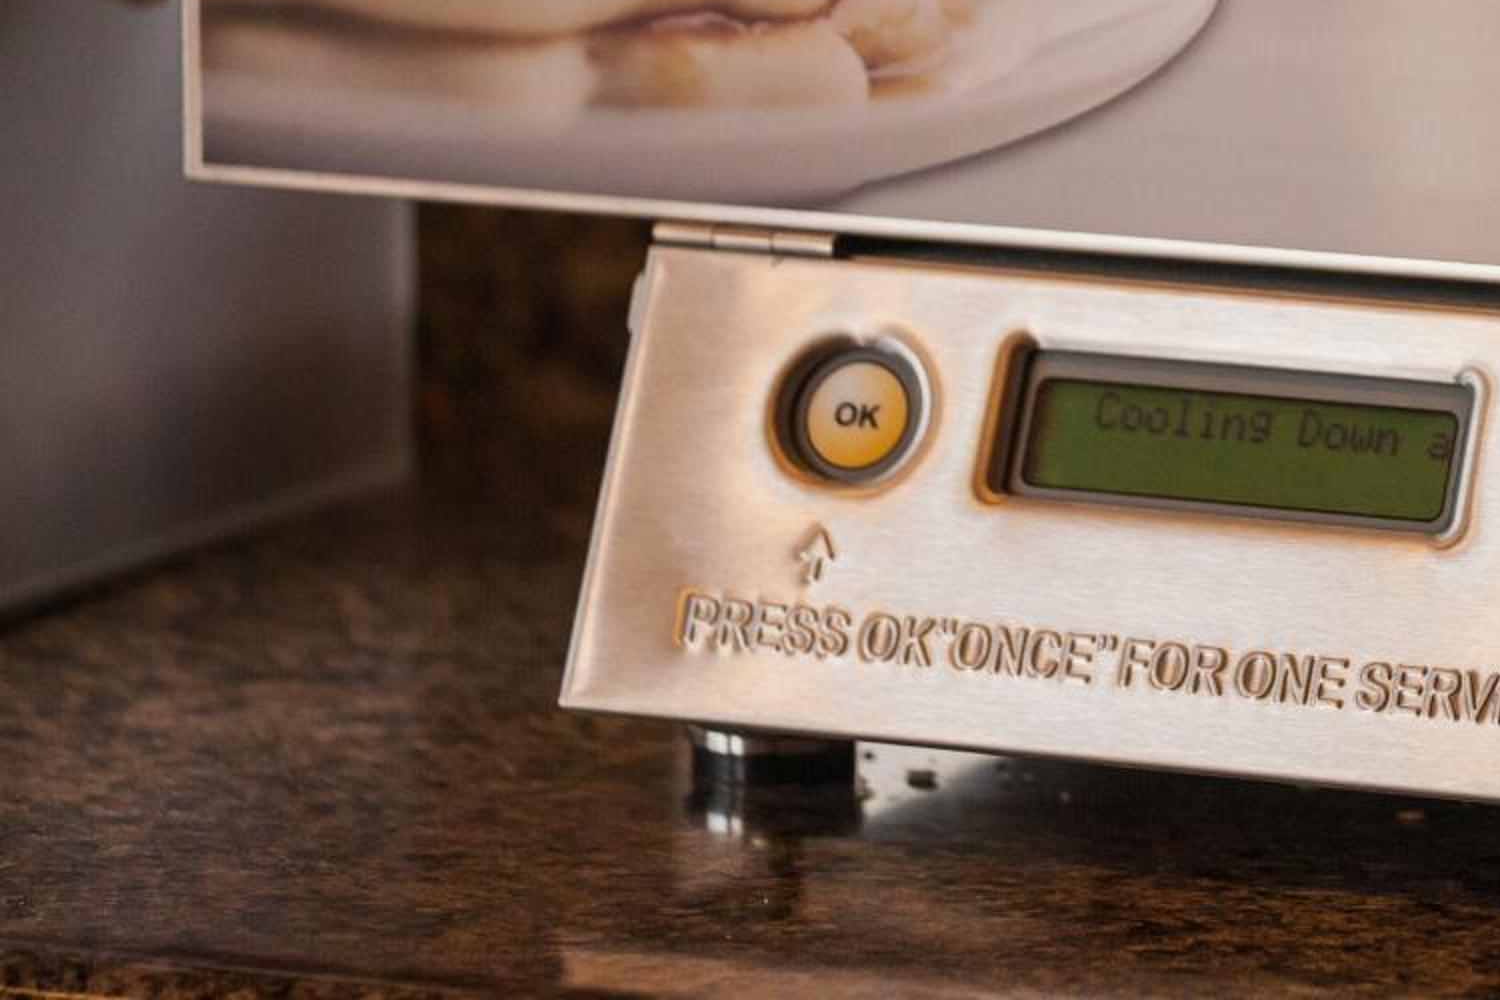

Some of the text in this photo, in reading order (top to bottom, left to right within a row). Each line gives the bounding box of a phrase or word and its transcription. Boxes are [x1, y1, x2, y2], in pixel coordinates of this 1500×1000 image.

[834, 402, 881, 431] OK
[1094, 391, 1274, 443] Cooling
[1296, 408, 1400, 457] Down
[677, 588, 853, 658] PRESS
[1234, 650, 1351, 710] ONE
